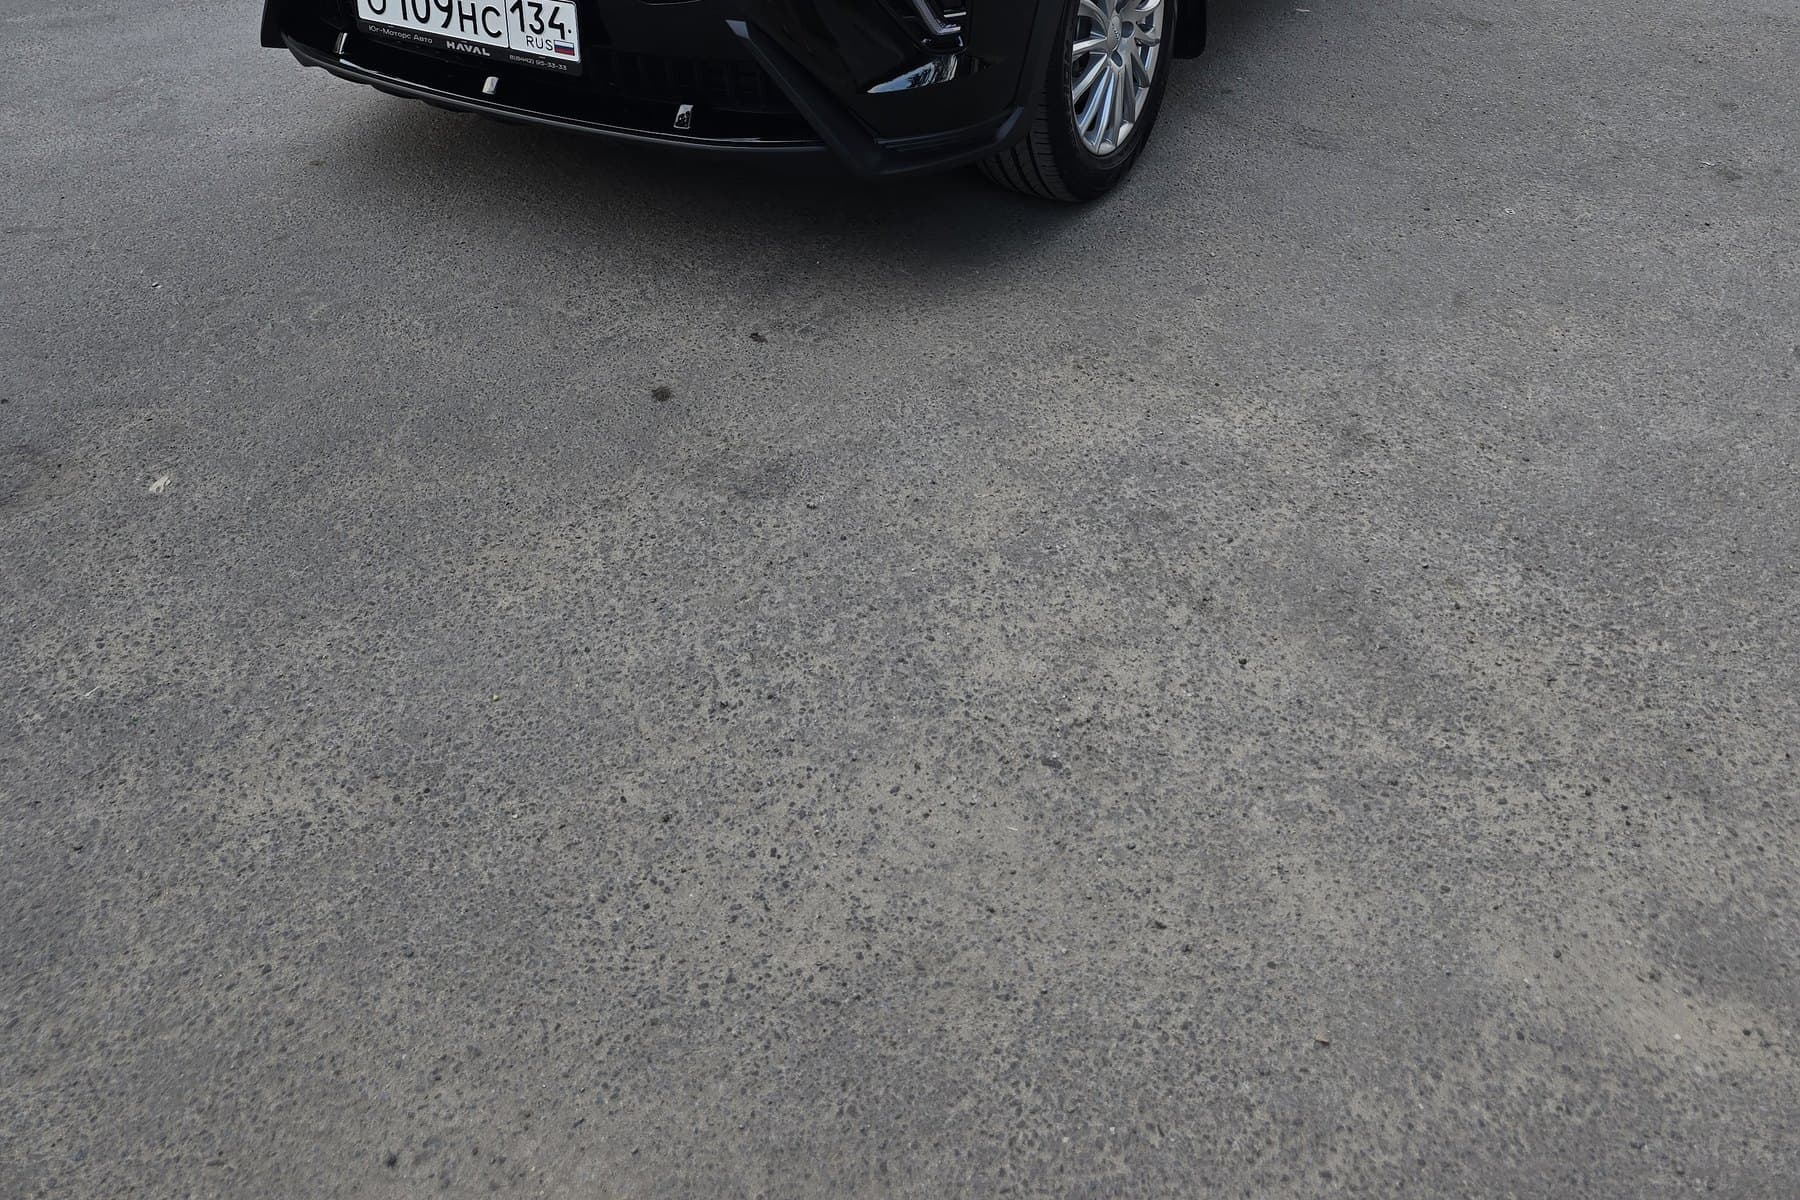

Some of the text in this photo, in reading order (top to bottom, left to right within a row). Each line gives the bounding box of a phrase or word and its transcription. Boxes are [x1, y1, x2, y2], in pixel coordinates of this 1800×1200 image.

[510, 0, 565, 40] 134
[368, 25, 433, 44] Юг-Моторс Авто
[526, 35, 554, 51] RUS
[446, 40, 491, 57] HAVAL
